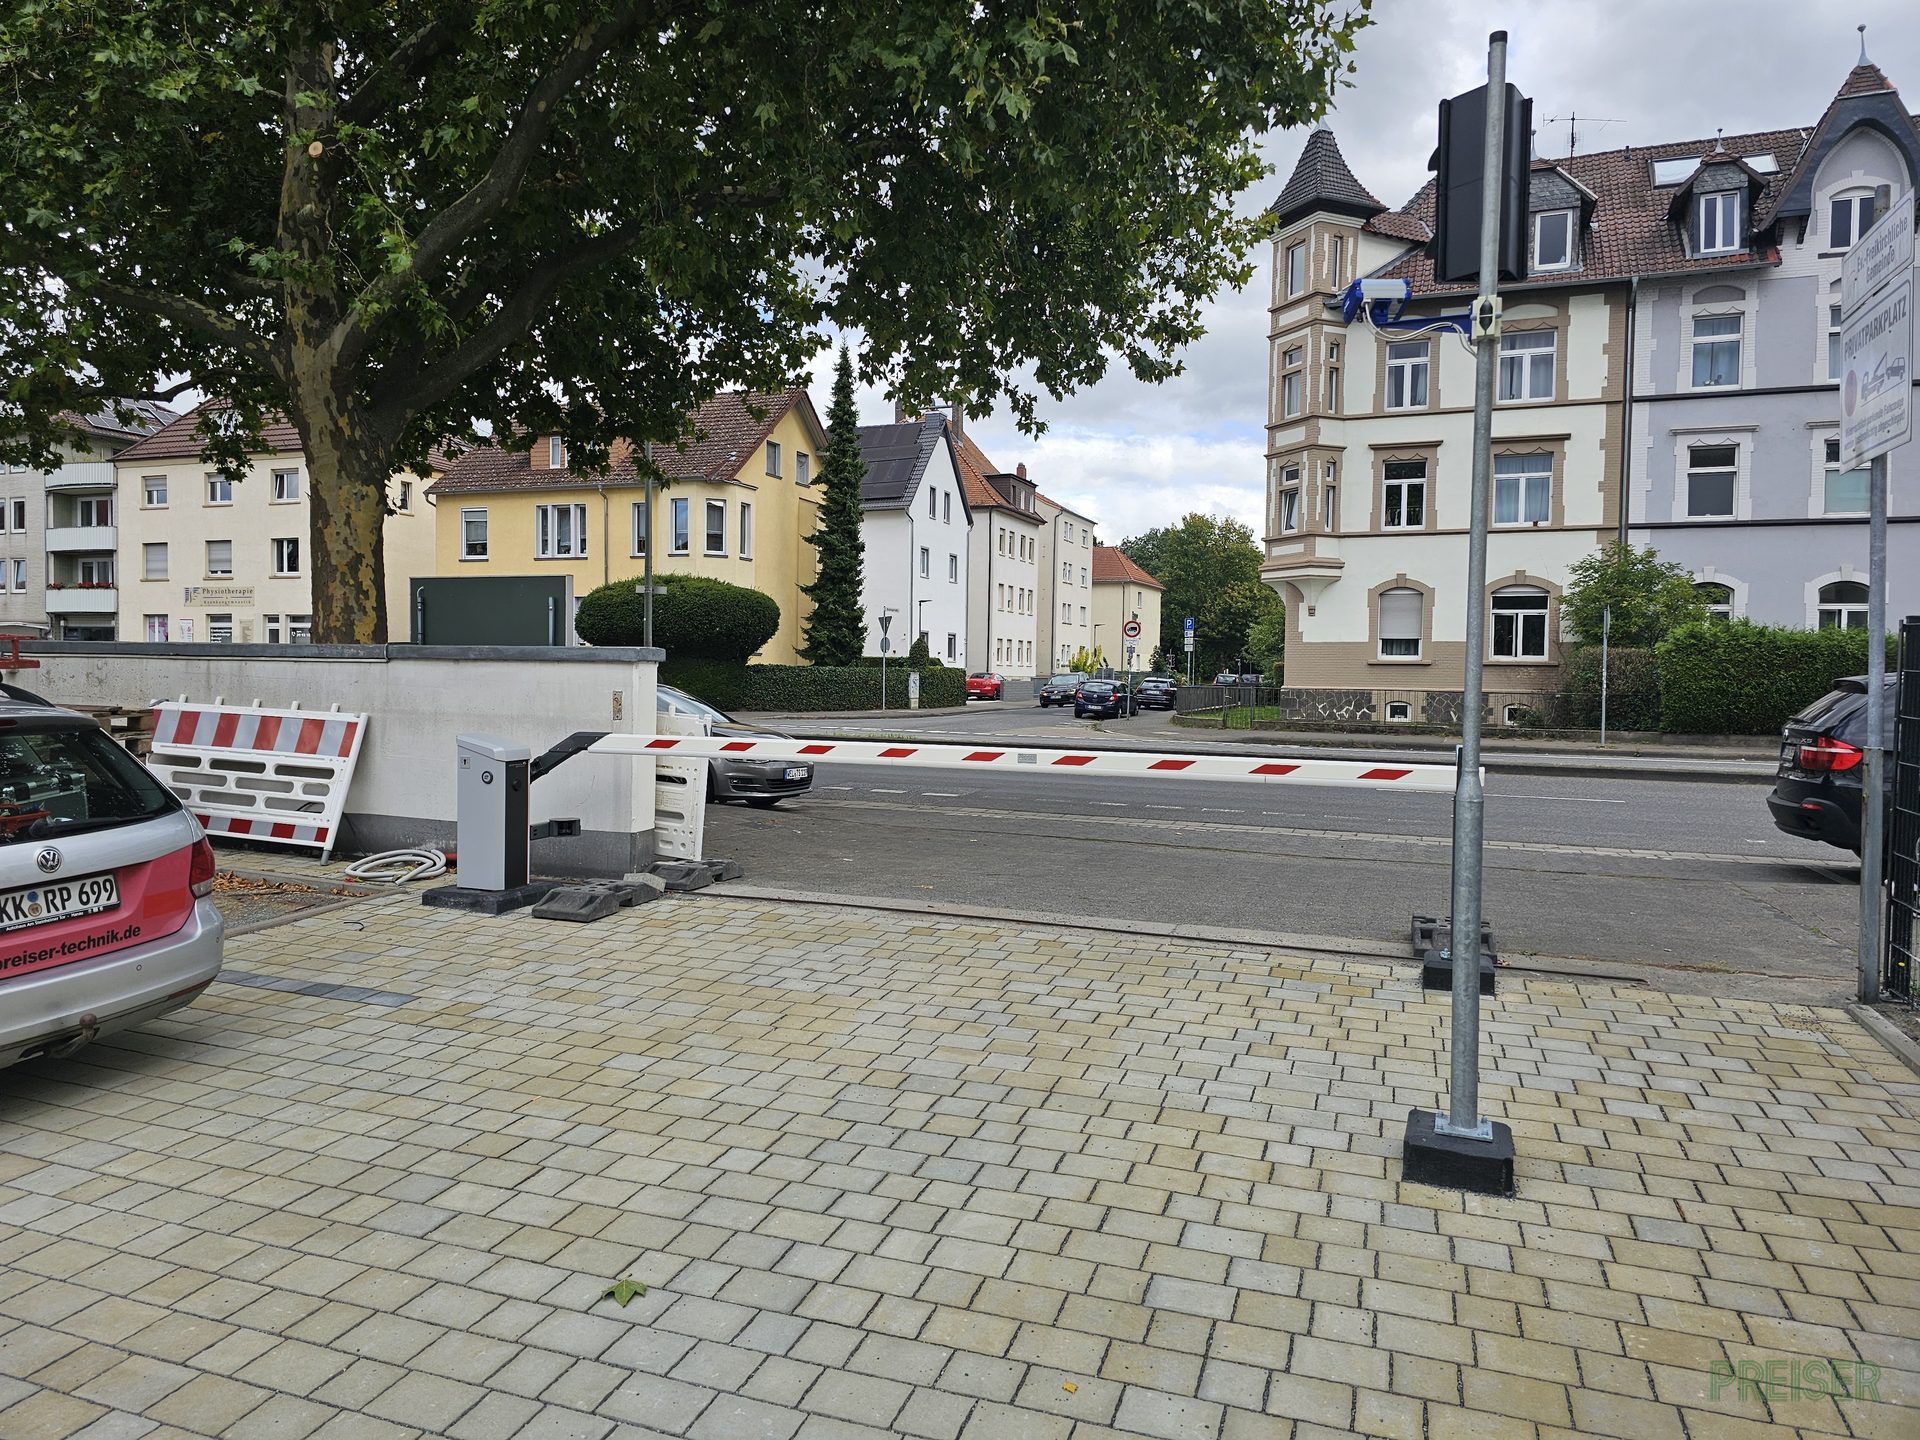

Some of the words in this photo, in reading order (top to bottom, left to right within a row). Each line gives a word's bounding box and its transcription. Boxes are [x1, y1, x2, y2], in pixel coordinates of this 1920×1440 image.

[1866, 246, 1895, 284] Gemeinde
[1844, 294, 1907, 362] PRIVATPARKPLATZ
[202, 588, 253, 596] Physiotherapie
[43, 886, 72, 914] RP
[78, 878, 115, 906] 699
